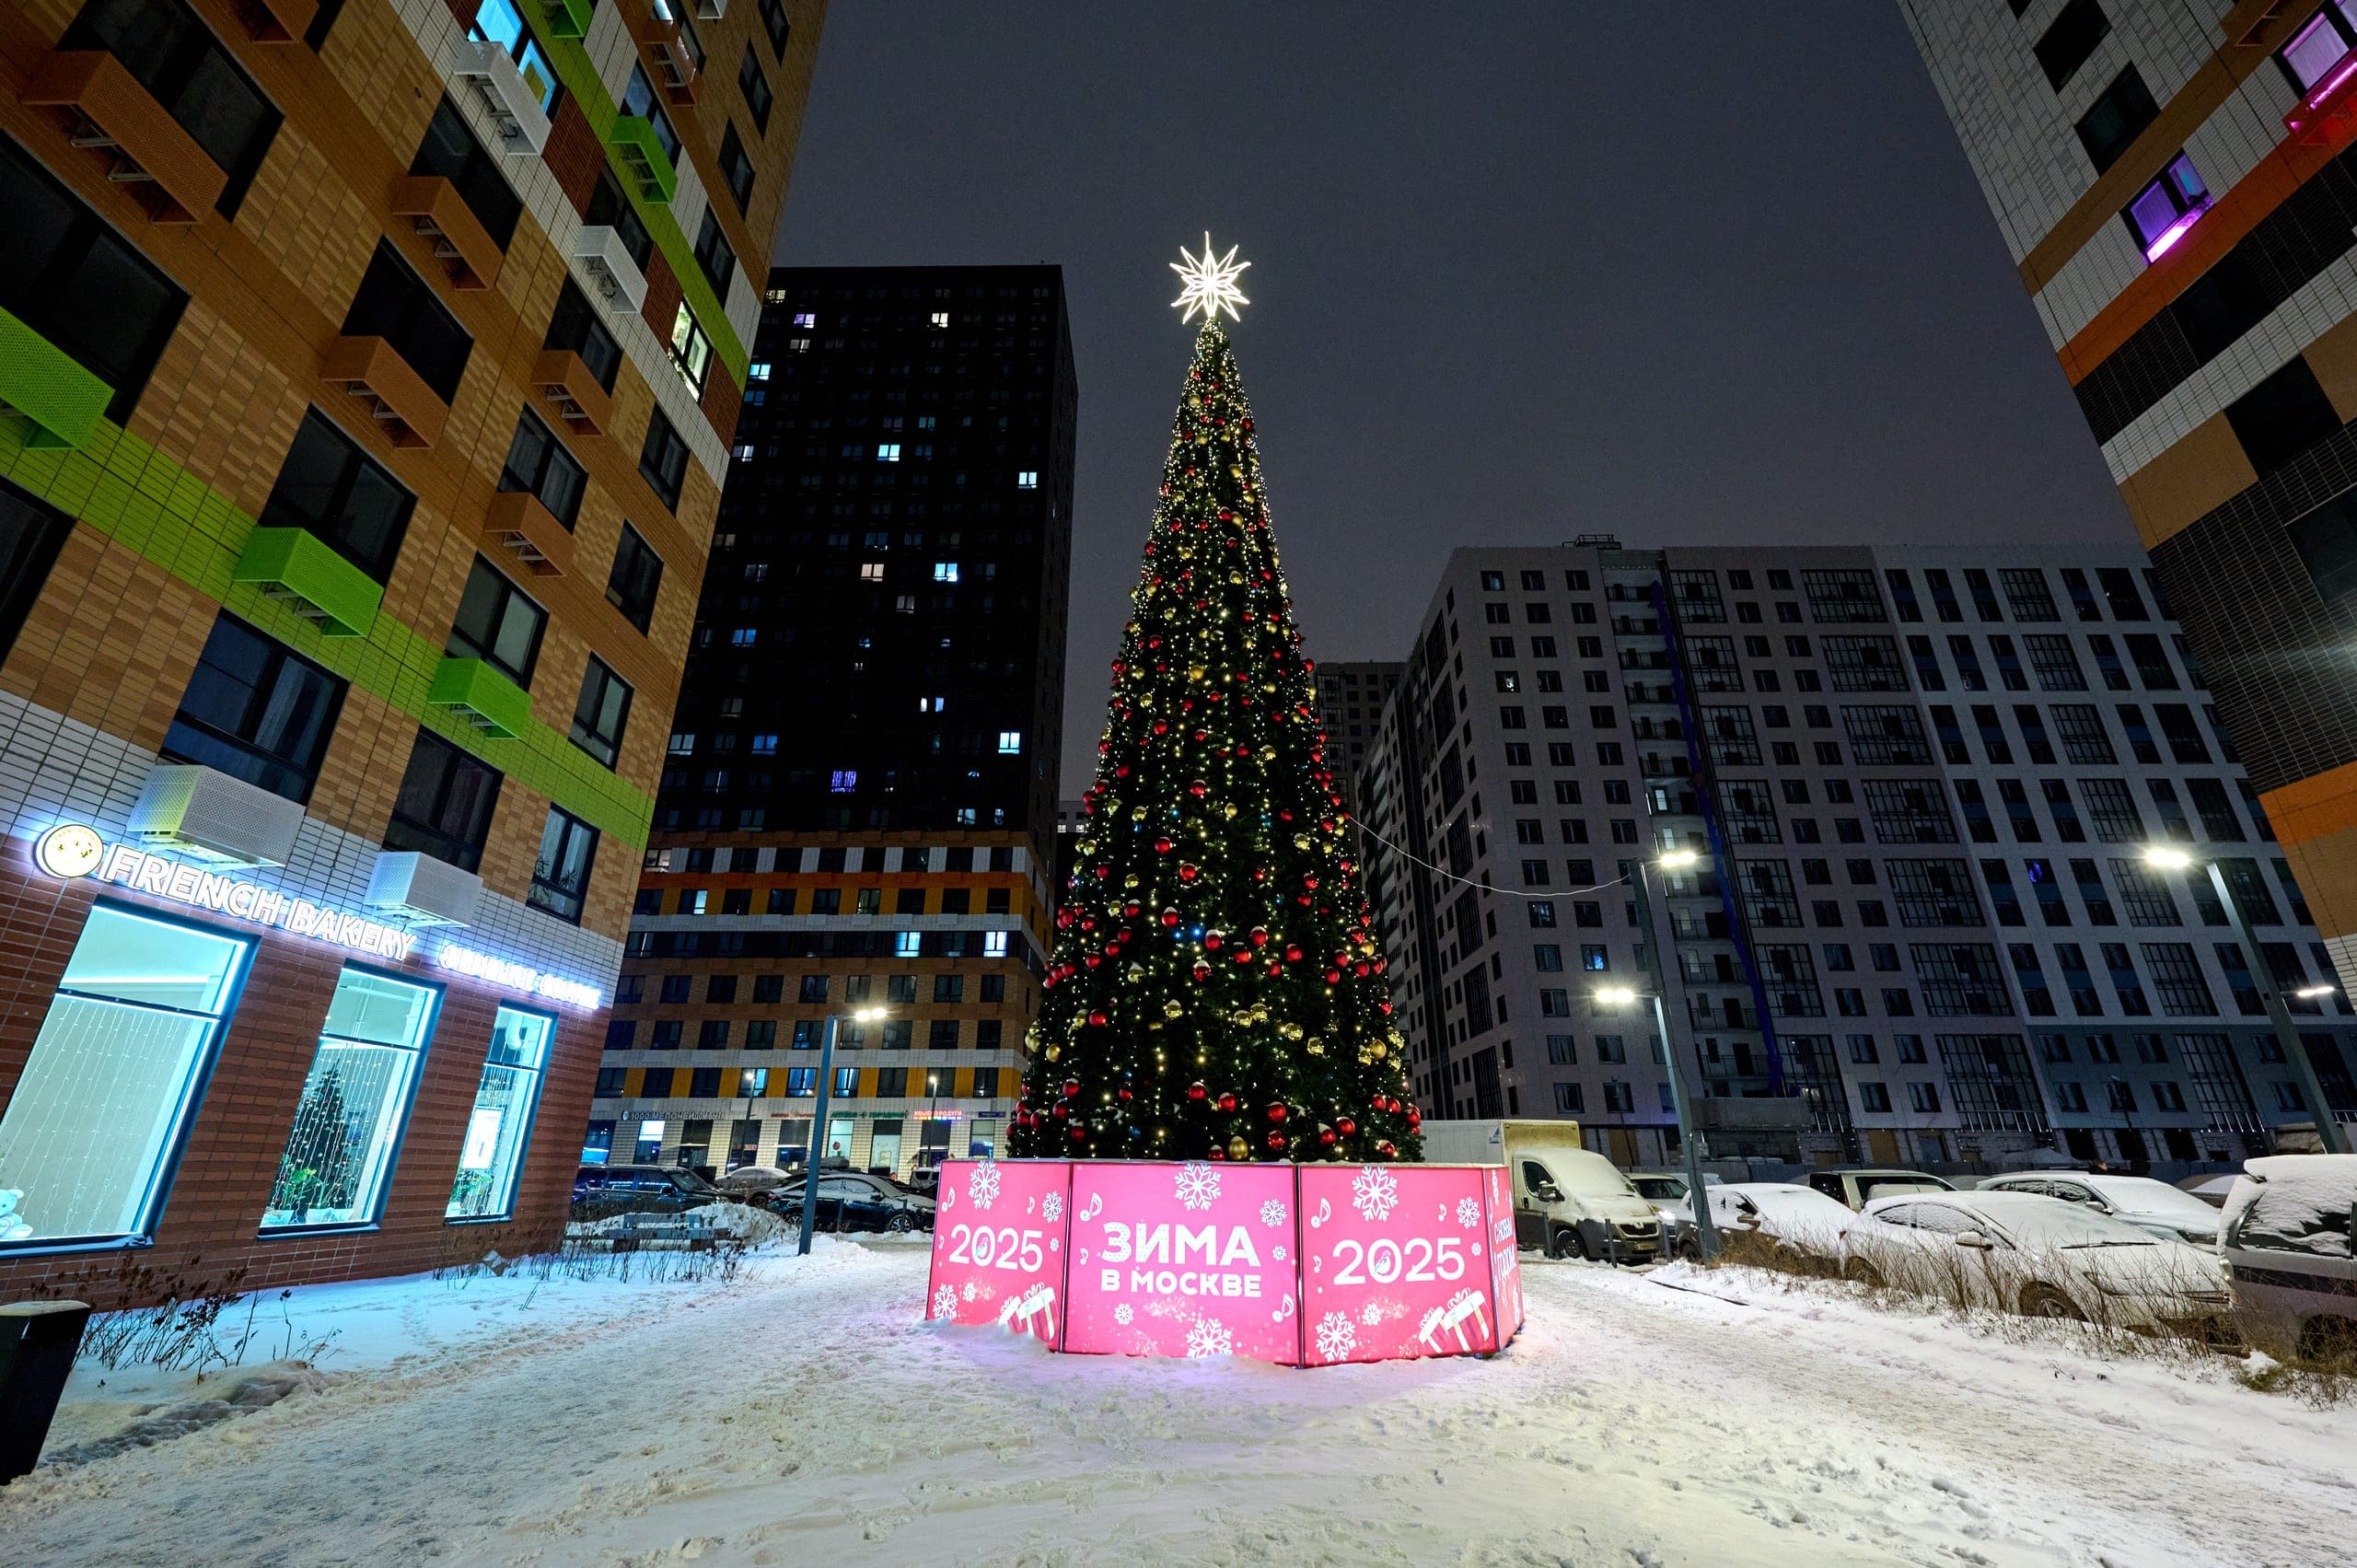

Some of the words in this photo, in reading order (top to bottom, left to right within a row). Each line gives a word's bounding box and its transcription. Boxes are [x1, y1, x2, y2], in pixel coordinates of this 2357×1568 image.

[102, 843, 285, 925] FRENCH
[287, 898, 417, 960] BAKERY
[949, 1224, 1043, 1272] 2025
[1101, 1221, 1261, 1268] ЗИМА
[1332, 1237, 1465, 1285] 2025
[1101, 1269, 1120, 1292] В
[1131, 1270, 1262, 1298] МОСКВЕ
